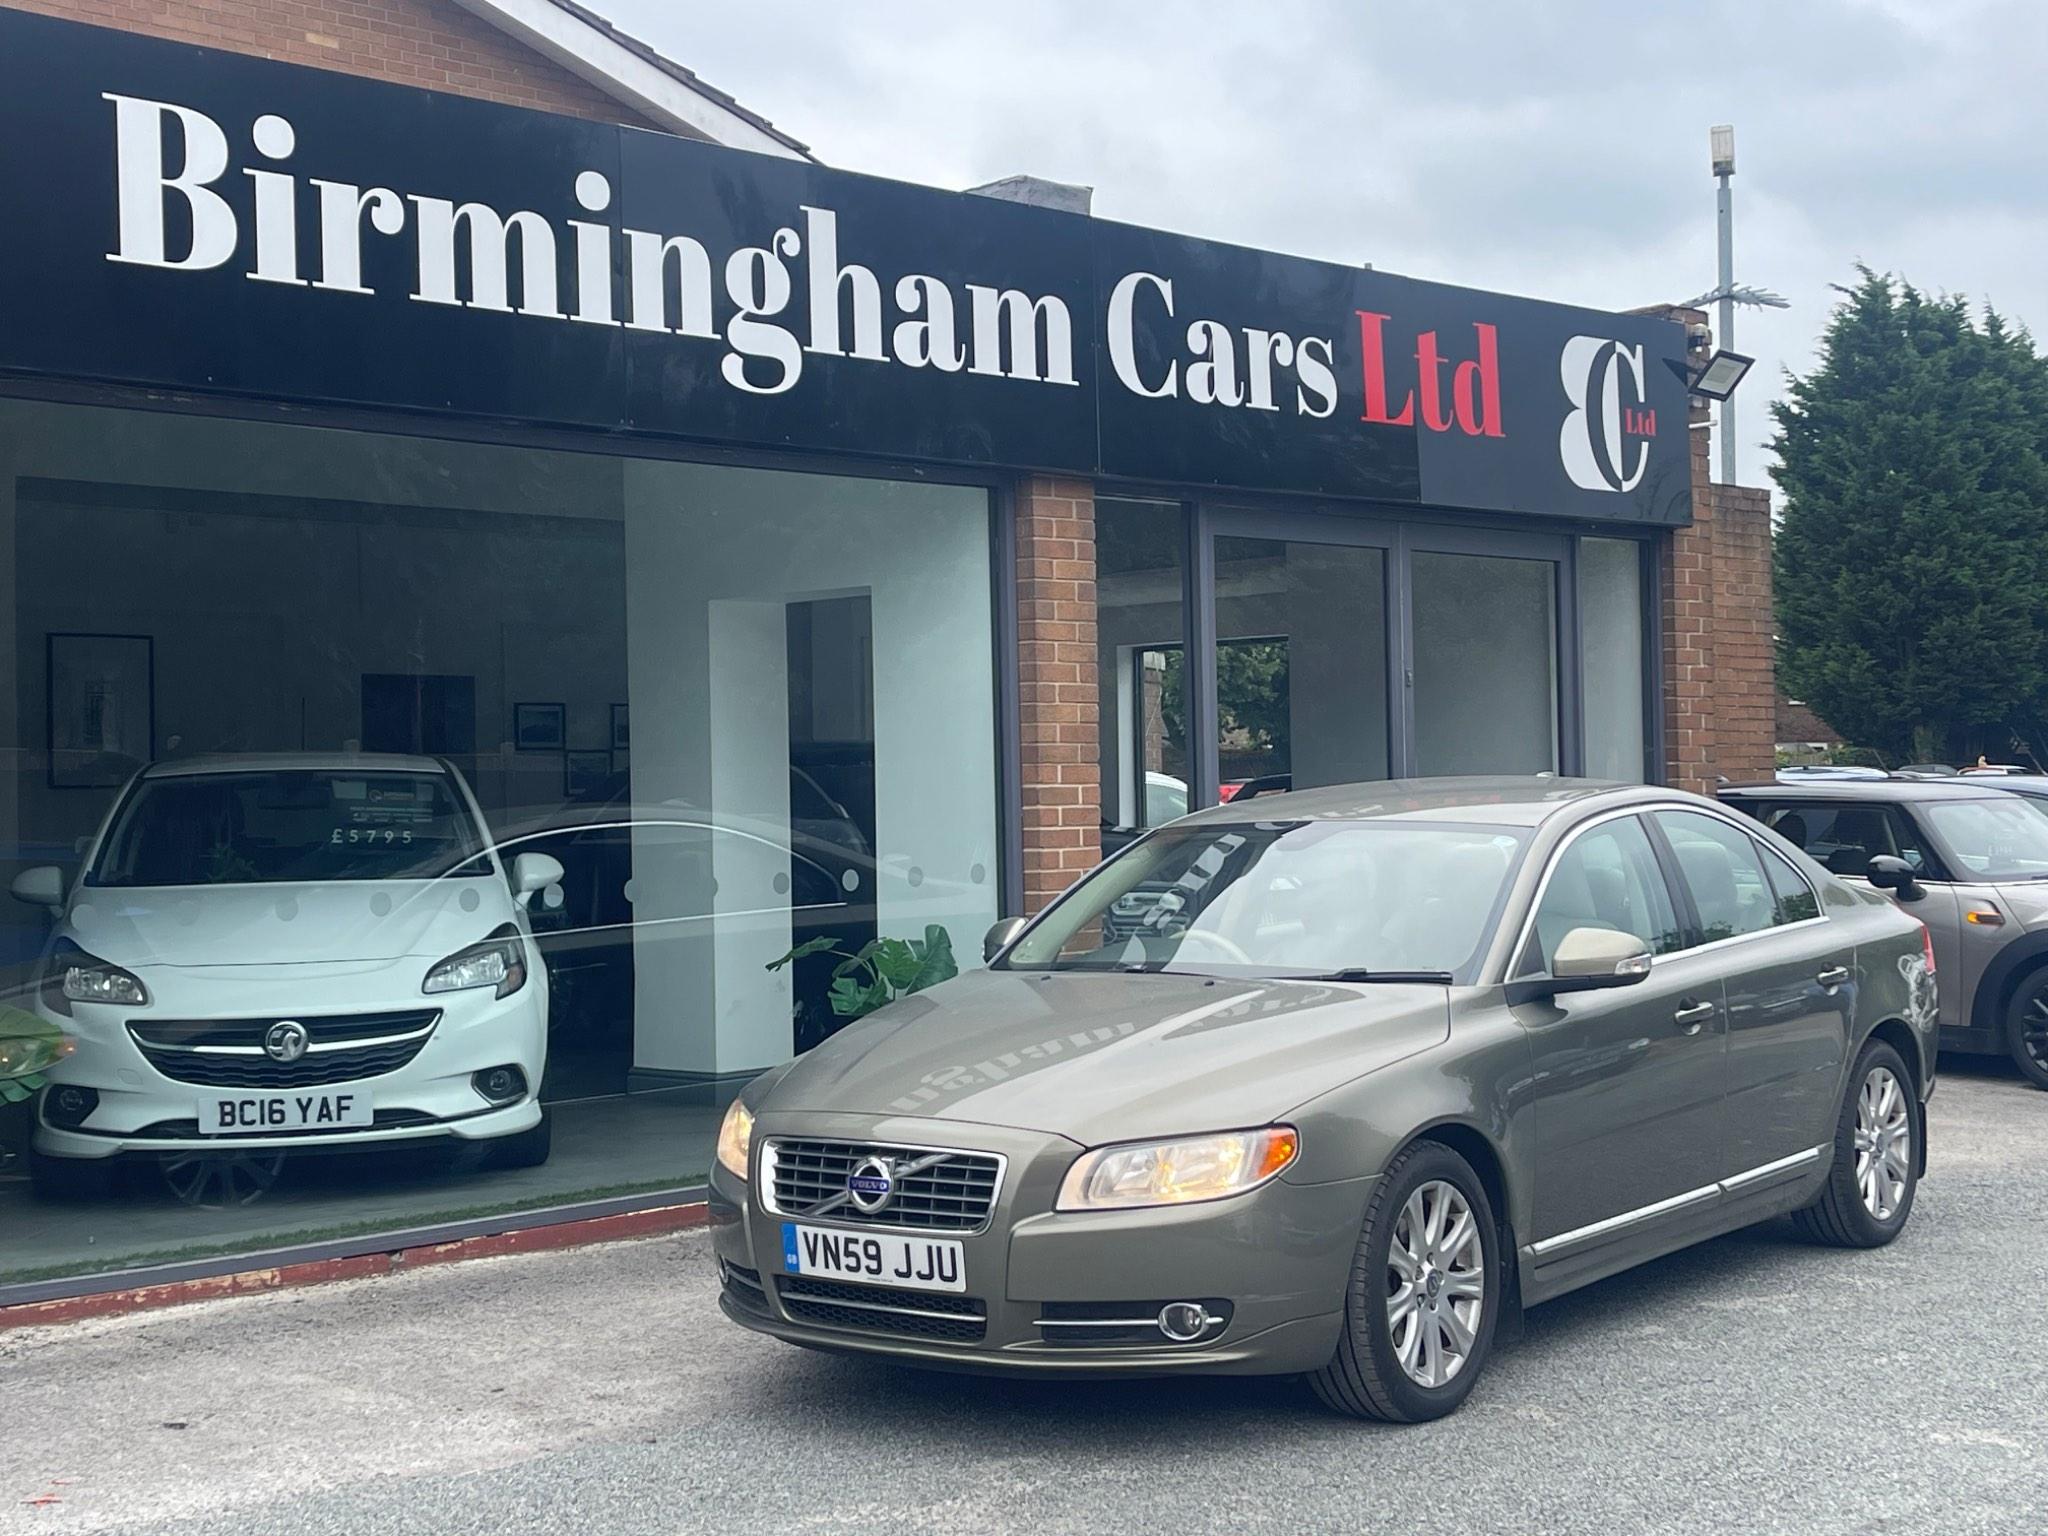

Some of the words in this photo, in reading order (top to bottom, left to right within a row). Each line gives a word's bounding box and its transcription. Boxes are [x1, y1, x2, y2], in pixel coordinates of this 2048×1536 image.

[102, 92, 1080, 394] Birmingham
[1107, 271, 1339, 419] Cars
[1355, 310, 1507, 438] Ltd
[1624, 408, 1657, 436] Ltd
[331, 828, 412, 844] £5795
[219, 1099, 286, 1127] BC16
[296, 1095, 354, 1123] YAF
[851, 1179, 888, 1190] VOLVO
[803, 1231, 882, 1275] VN59
[894, 1243, 958, 1282] JJU
